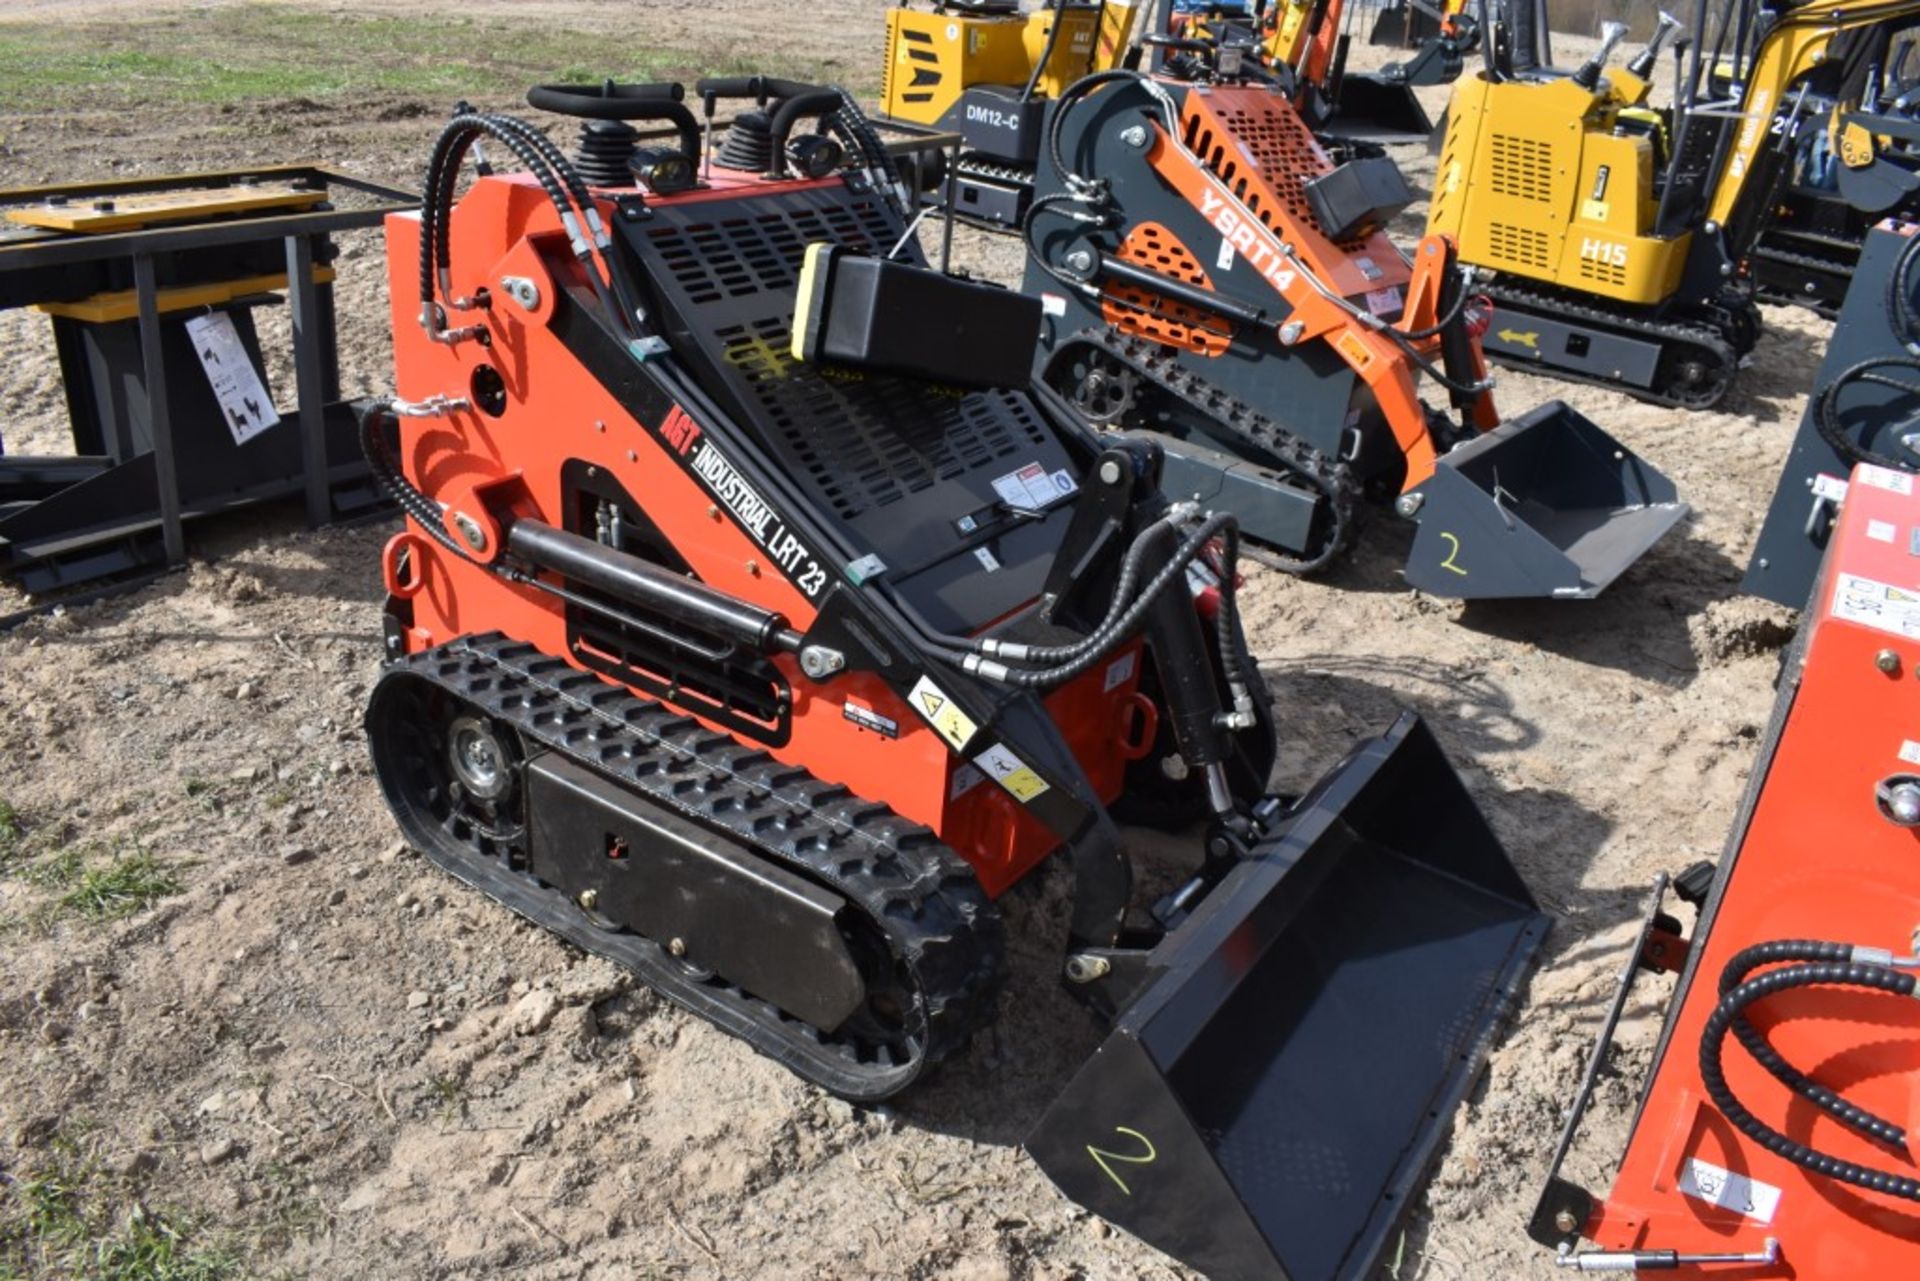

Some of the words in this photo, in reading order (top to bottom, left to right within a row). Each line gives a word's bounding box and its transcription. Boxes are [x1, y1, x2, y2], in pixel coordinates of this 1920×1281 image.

[967, 105, 1019, 130] DM12-C
[1201, 187, 1296, 292] YSRT14
[1581, 238, 1627, 267] H15
[659, 402, 702, 456] AGT
[695, 442, 773, 539] INDUSTRIAL
[767, 525, 808, 573] LRT
[797, 561, 826, 597] 23
[1441, 532, 1467, 575] 2
[1087, 1126, 1156, 1196] 2
